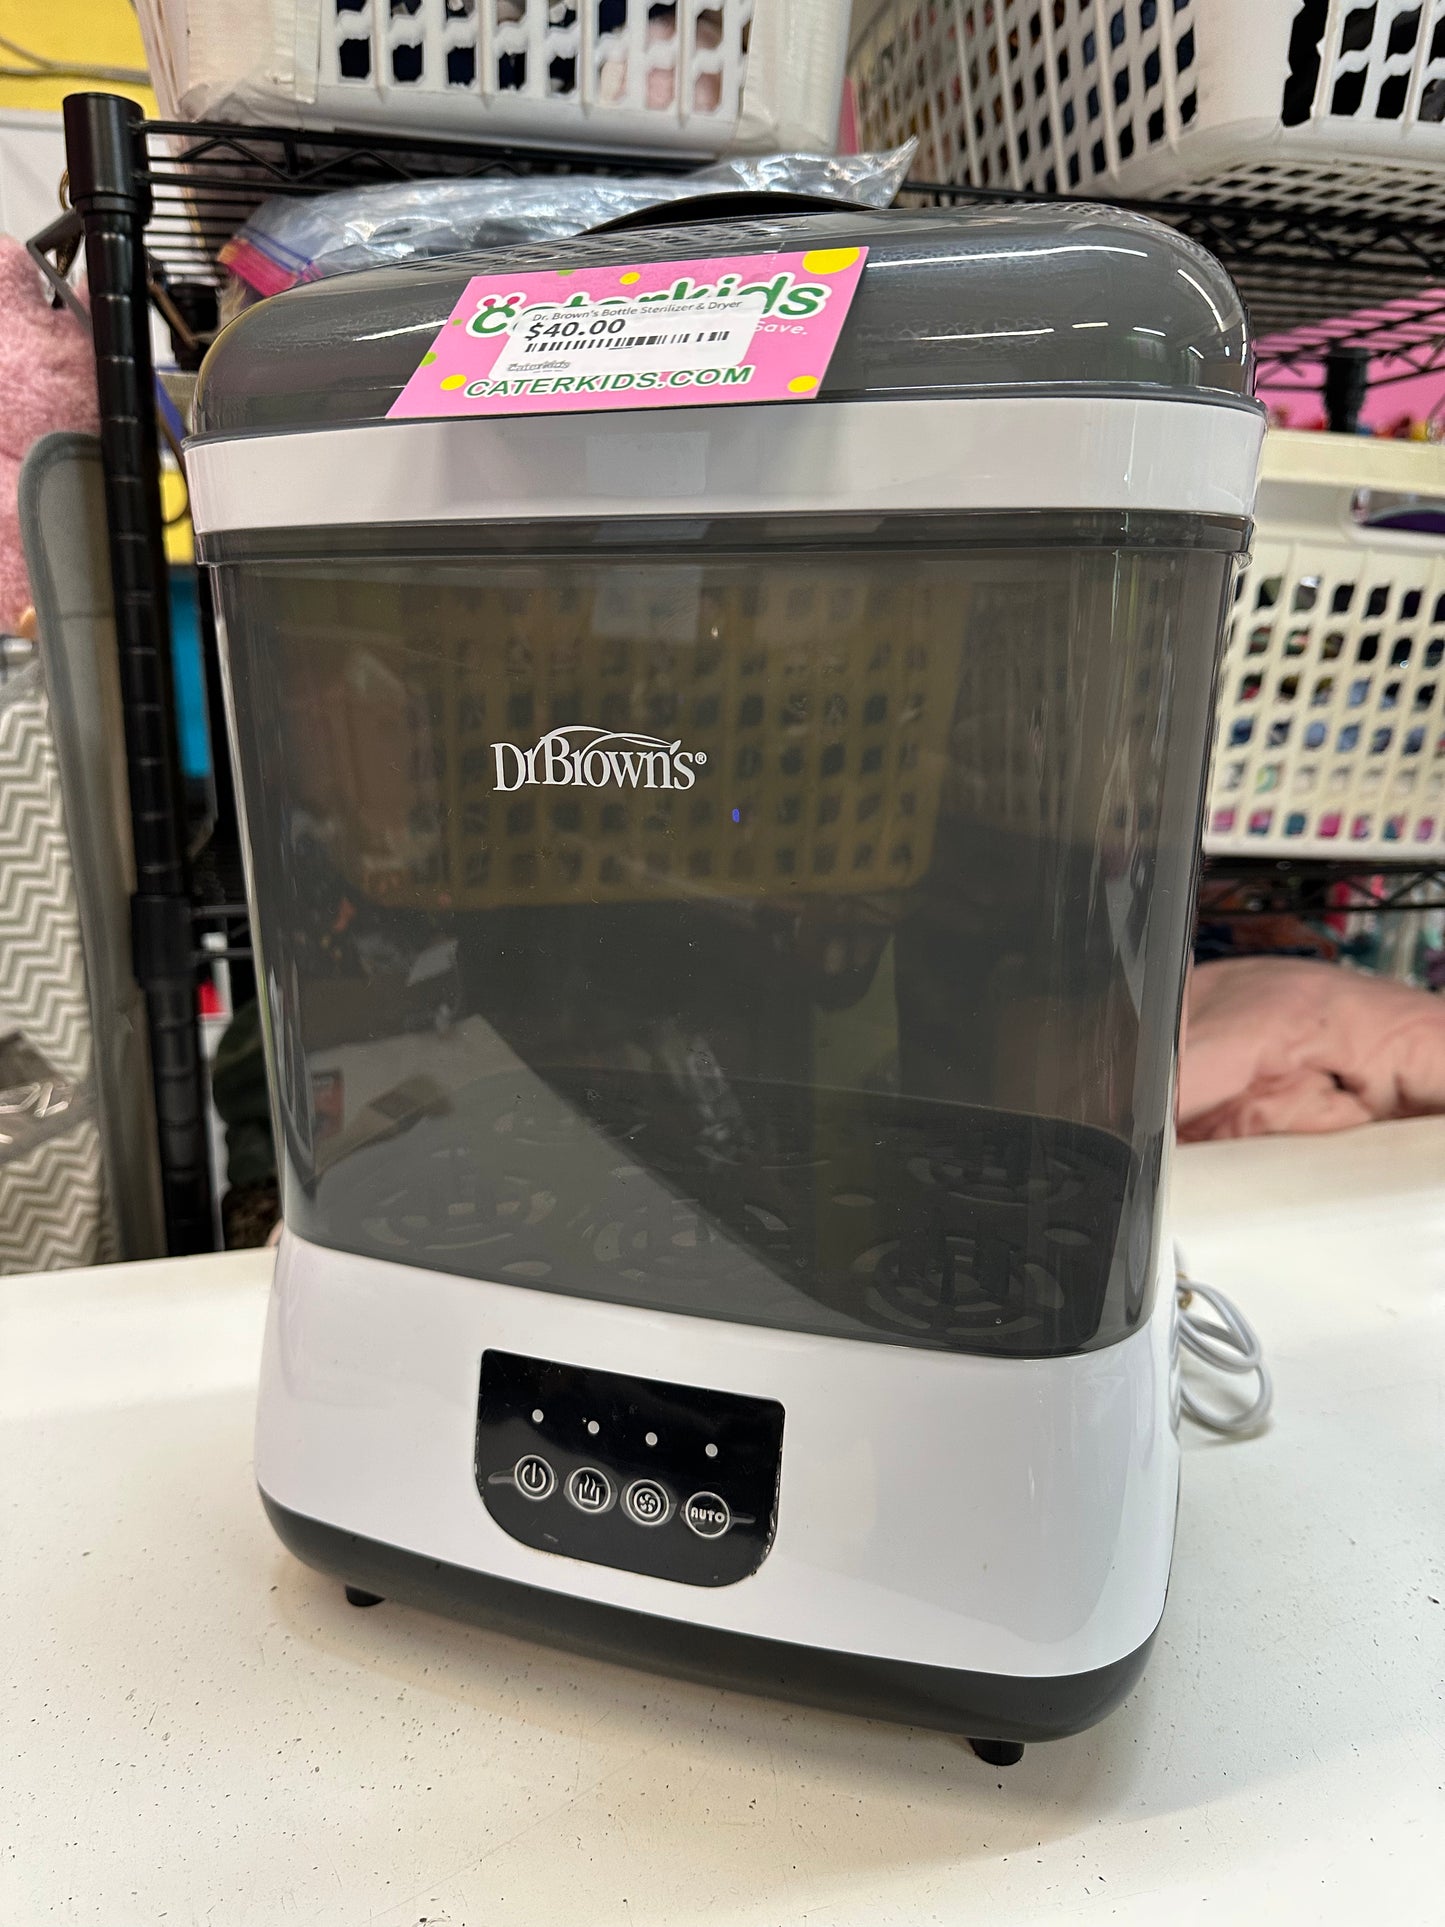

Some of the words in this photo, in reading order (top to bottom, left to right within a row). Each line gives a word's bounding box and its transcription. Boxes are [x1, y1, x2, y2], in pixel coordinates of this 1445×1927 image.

[532, 314, 549, 322] Dr.
[552, 309, 599, 321] Brown's
[601, 306, 638, 317] Bottle
[641, 302, 694, 314] Sterilizer
[695, 302, 705, 310] &
[708, 300, 743, 310] Dryer
[525, 318, 626, 341] $40.00
[466, 367, 752, 396] CATERKIDS.COM
[690, 1506, 725, 1523] AUTO
